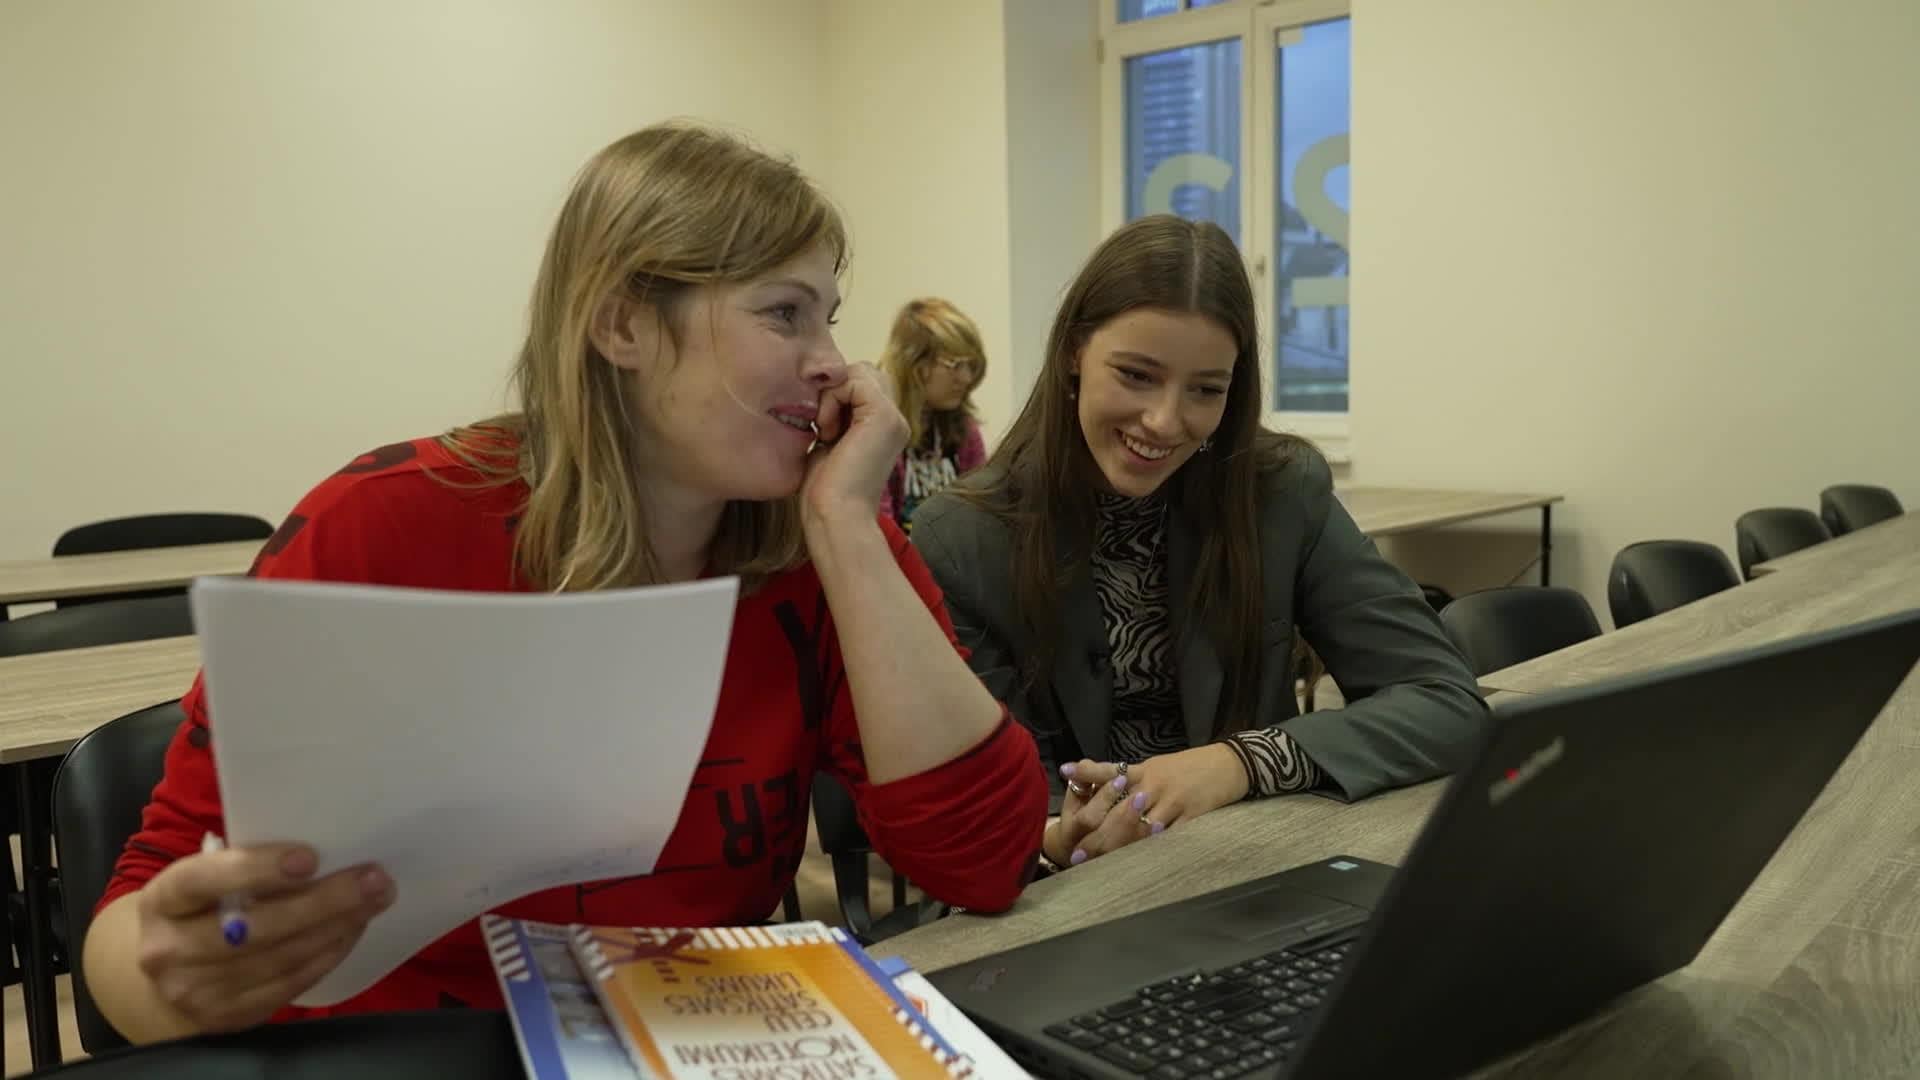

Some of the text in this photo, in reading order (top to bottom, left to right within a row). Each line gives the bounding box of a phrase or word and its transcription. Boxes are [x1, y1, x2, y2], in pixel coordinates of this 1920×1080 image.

[695, 971, 803, 993] LIKUMS
[664, 990, 819, 1015] SATIKSMES
[673, 1034, 859, 1065] NOTEIKUMI
